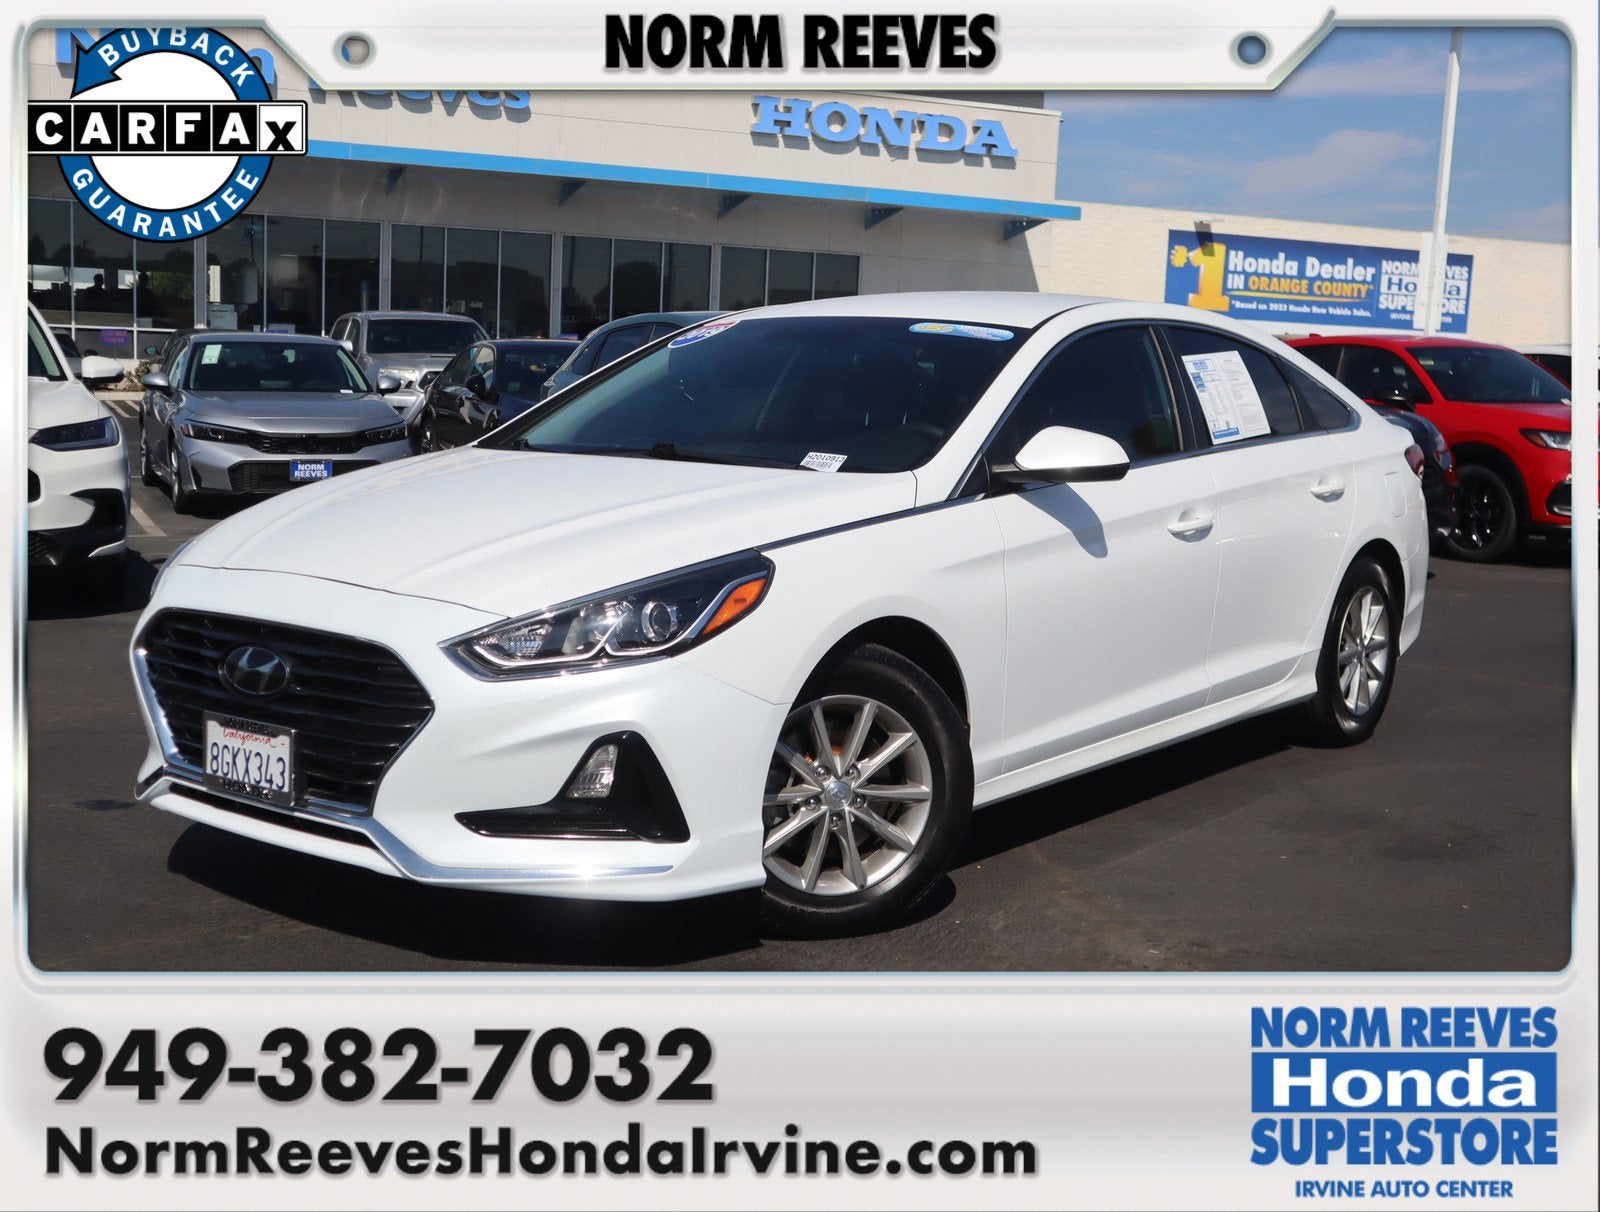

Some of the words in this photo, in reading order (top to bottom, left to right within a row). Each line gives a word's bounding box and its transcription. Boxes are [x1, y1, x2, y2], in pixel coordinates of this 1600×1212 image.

[751, 95, 1018, 160] HONDA
[1228, 249, 1298, 276] Honda
[1305, 256, 1376, 282] Dealer
[1226, 273, 1245, 290] IN
[1248, 275, 1309, 292] ORANGE
[1288, 304, 1310, 314] Honda
[1311, 305, 1327, 315] New
[1328, 305, 1352, 316] Vehicle
[222, 727, 277, 748] California
[210, 741, 287, 792] 8GKX343
